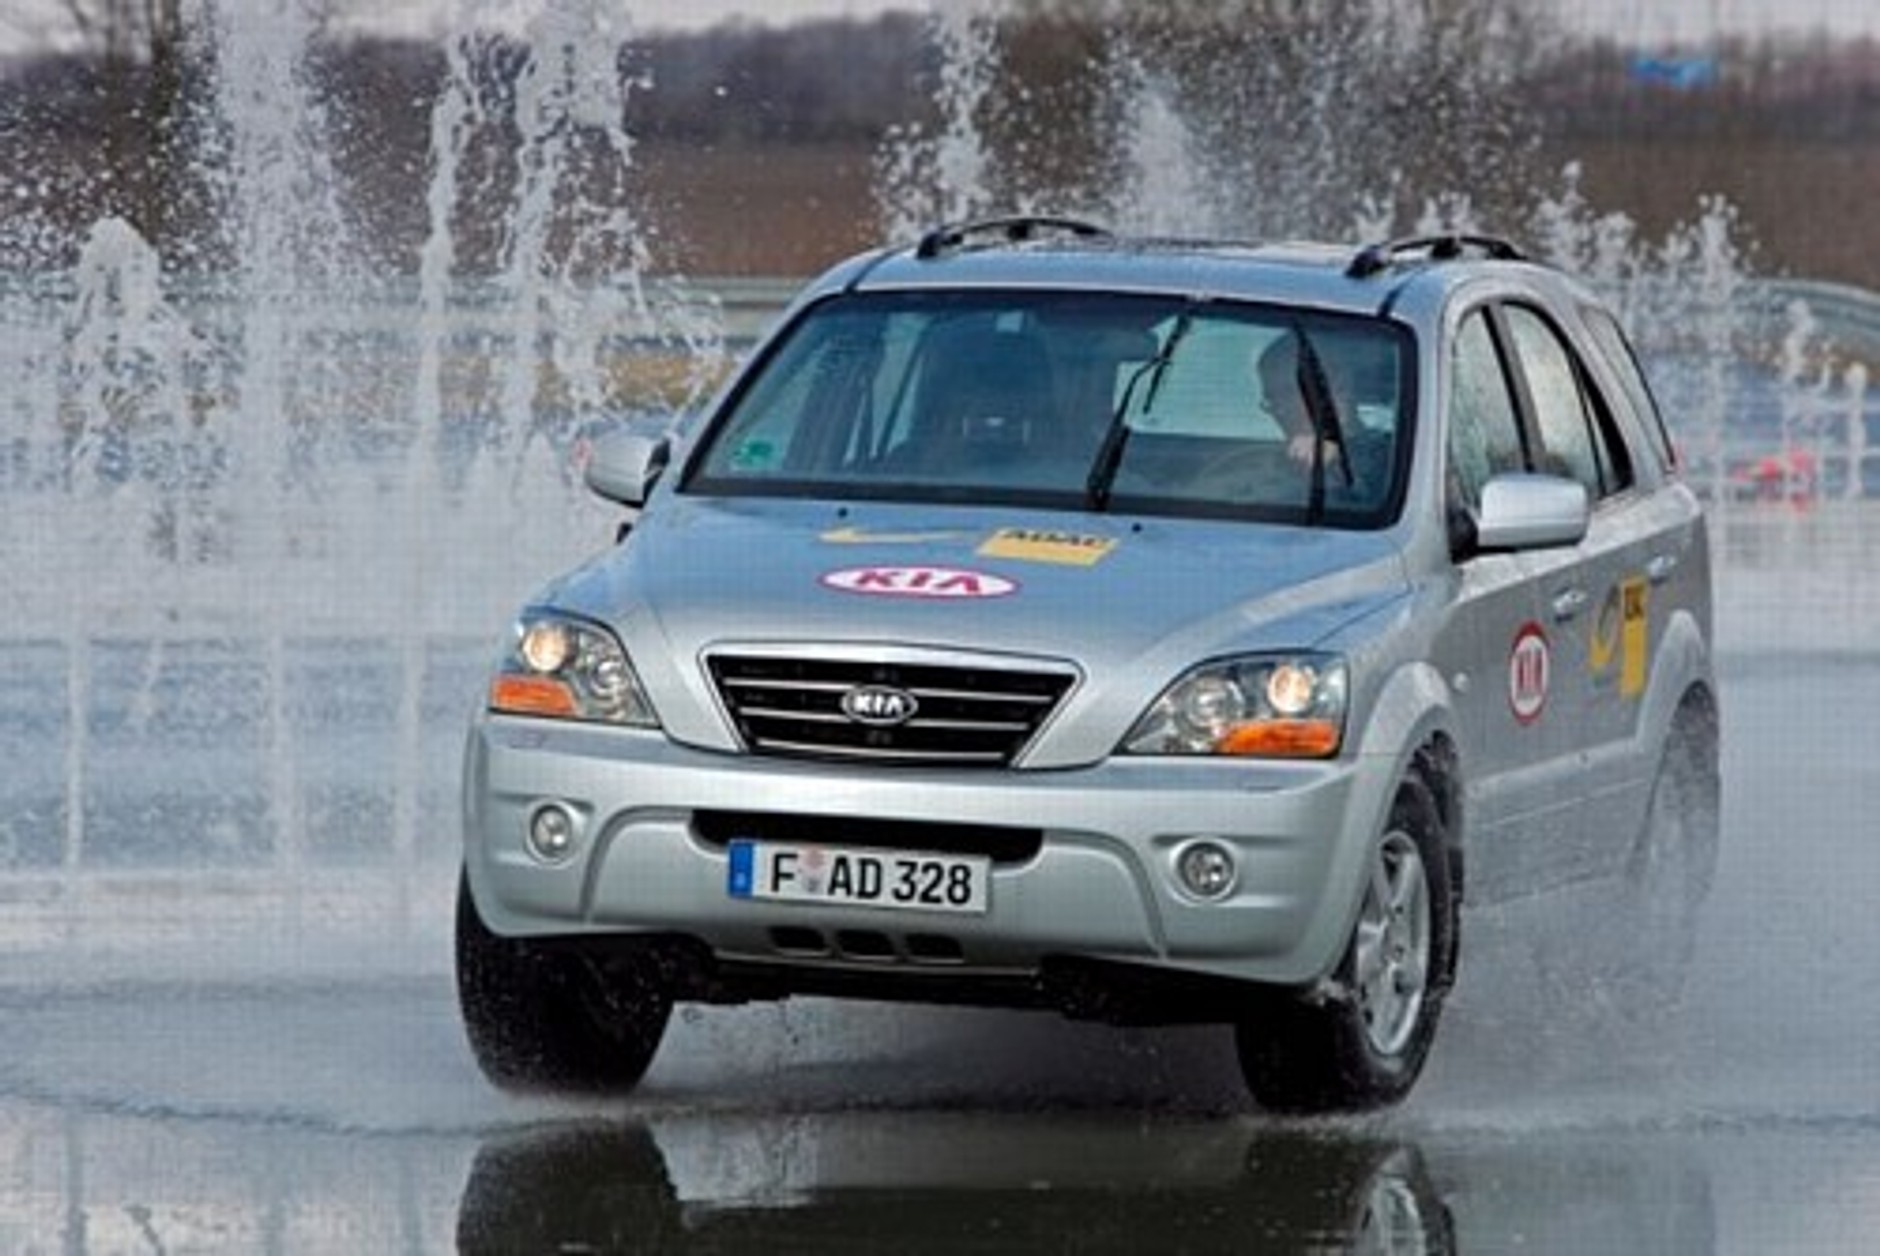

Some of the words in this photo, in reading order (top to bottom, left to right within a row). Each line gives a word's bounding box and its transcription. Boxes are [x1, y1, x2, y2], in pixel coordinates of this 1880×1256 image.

[856, 571, 983, 593] KIA
[852, 693, 904, 714] KIA
[771, 853, 798, 893] F
[827, 856, 883, 900] AD
[892, 860, 972, 905] 328
